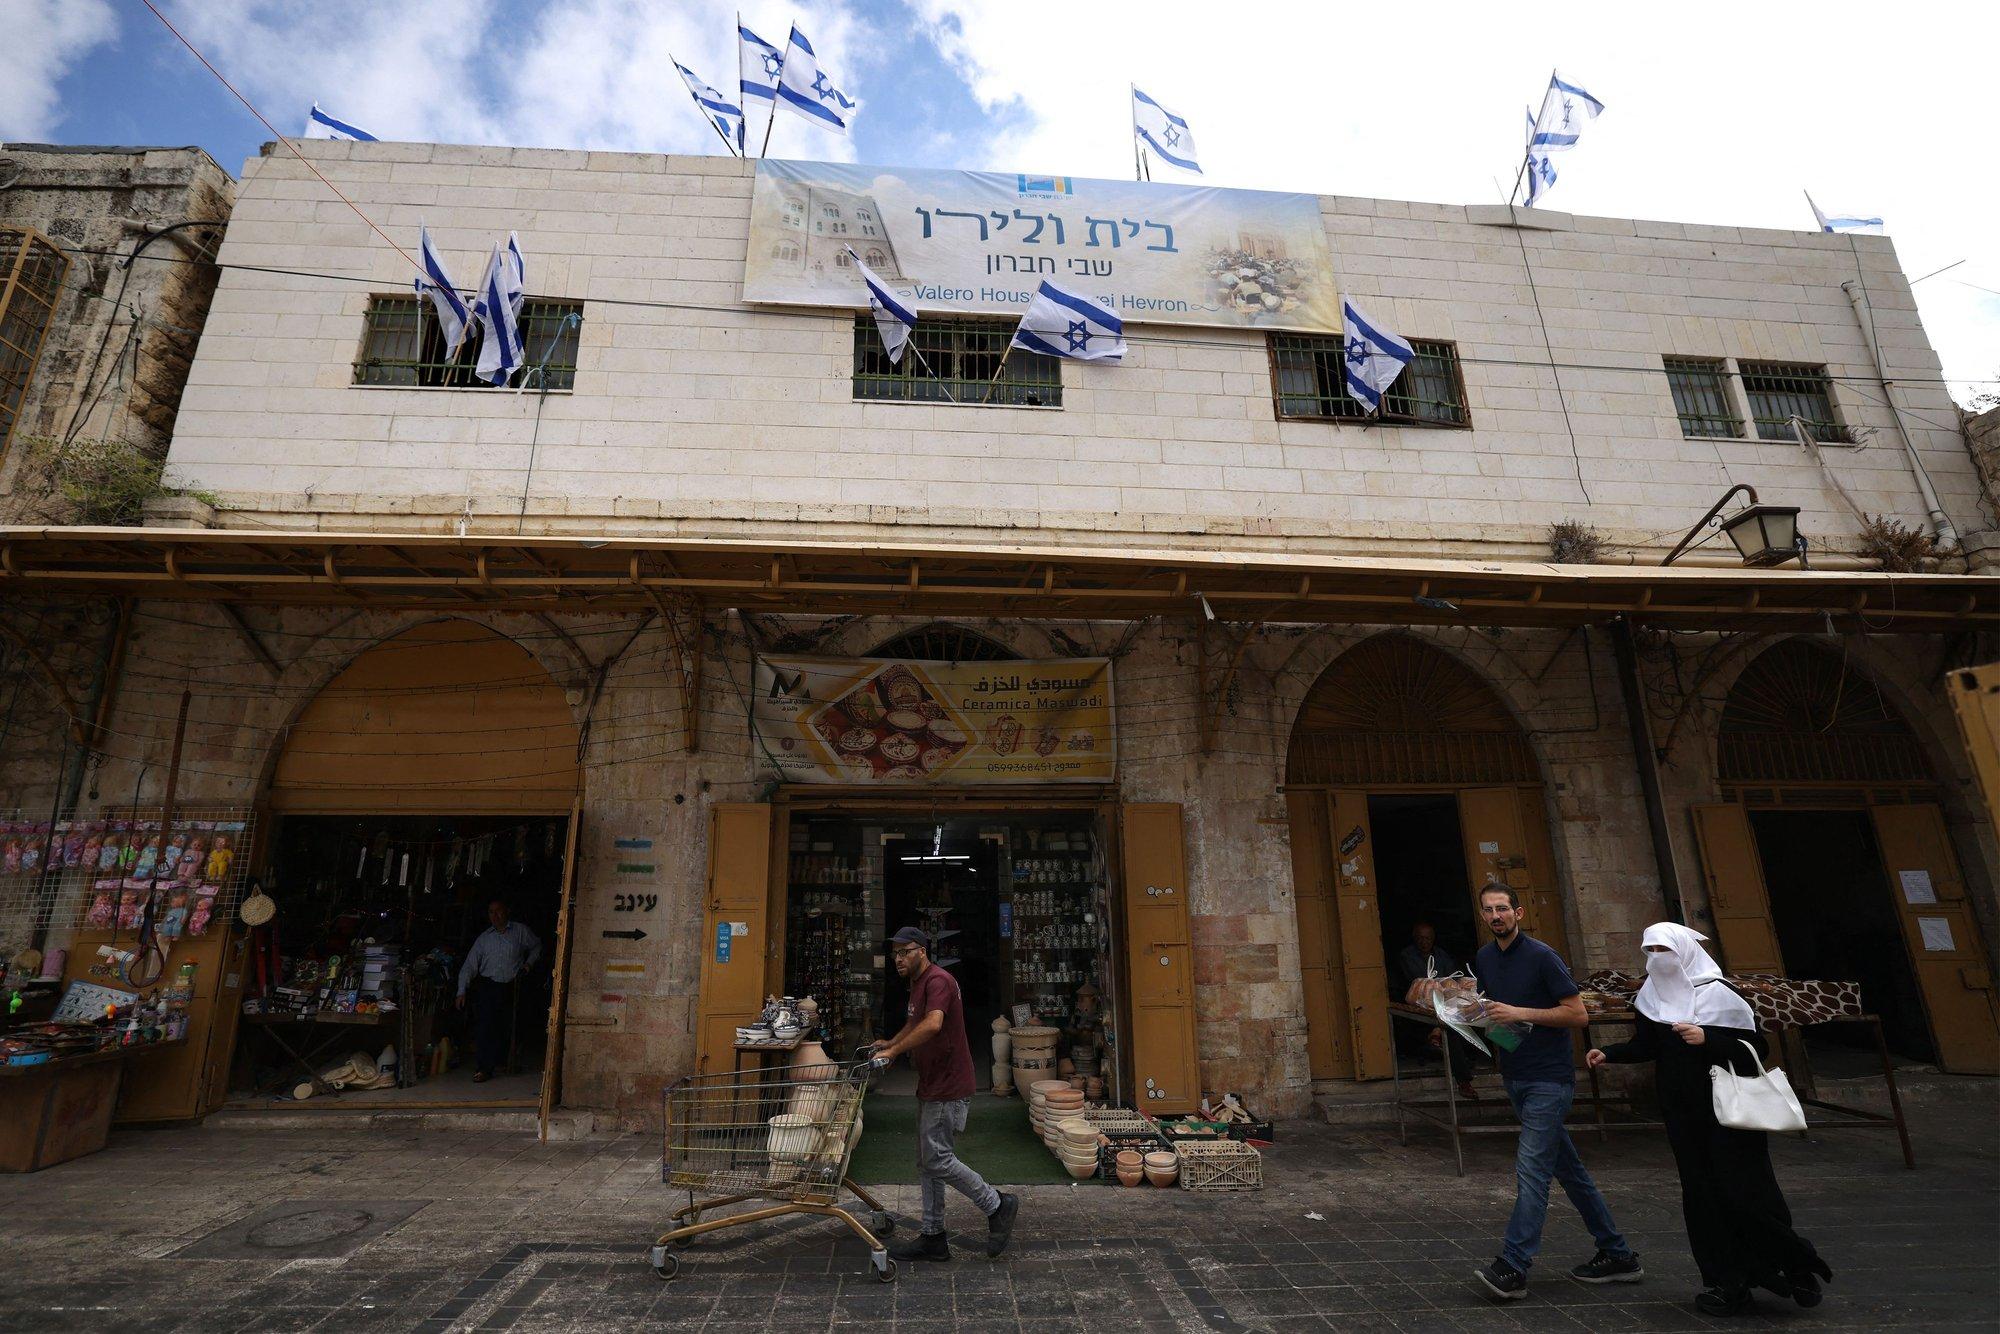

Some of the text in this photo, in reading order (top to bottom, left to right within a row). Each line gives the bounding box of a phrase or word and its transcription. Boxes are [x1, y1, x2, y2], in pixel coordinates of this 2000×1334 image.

[915, 206, 1179, 254] בית ולירו
[987, 254, 1113, 277] שבי חברון
[914, 284, 974, 302] Valero
[1122, 294, 1188, 312] Hevron
[973, 675, 1091, 695] مسودي للخزف
[962, 695, 1103, 711] Ceramica Maswadi
[987, 762, 1052, 773] 0599368451
[614, 893, 658, 912] עינב
